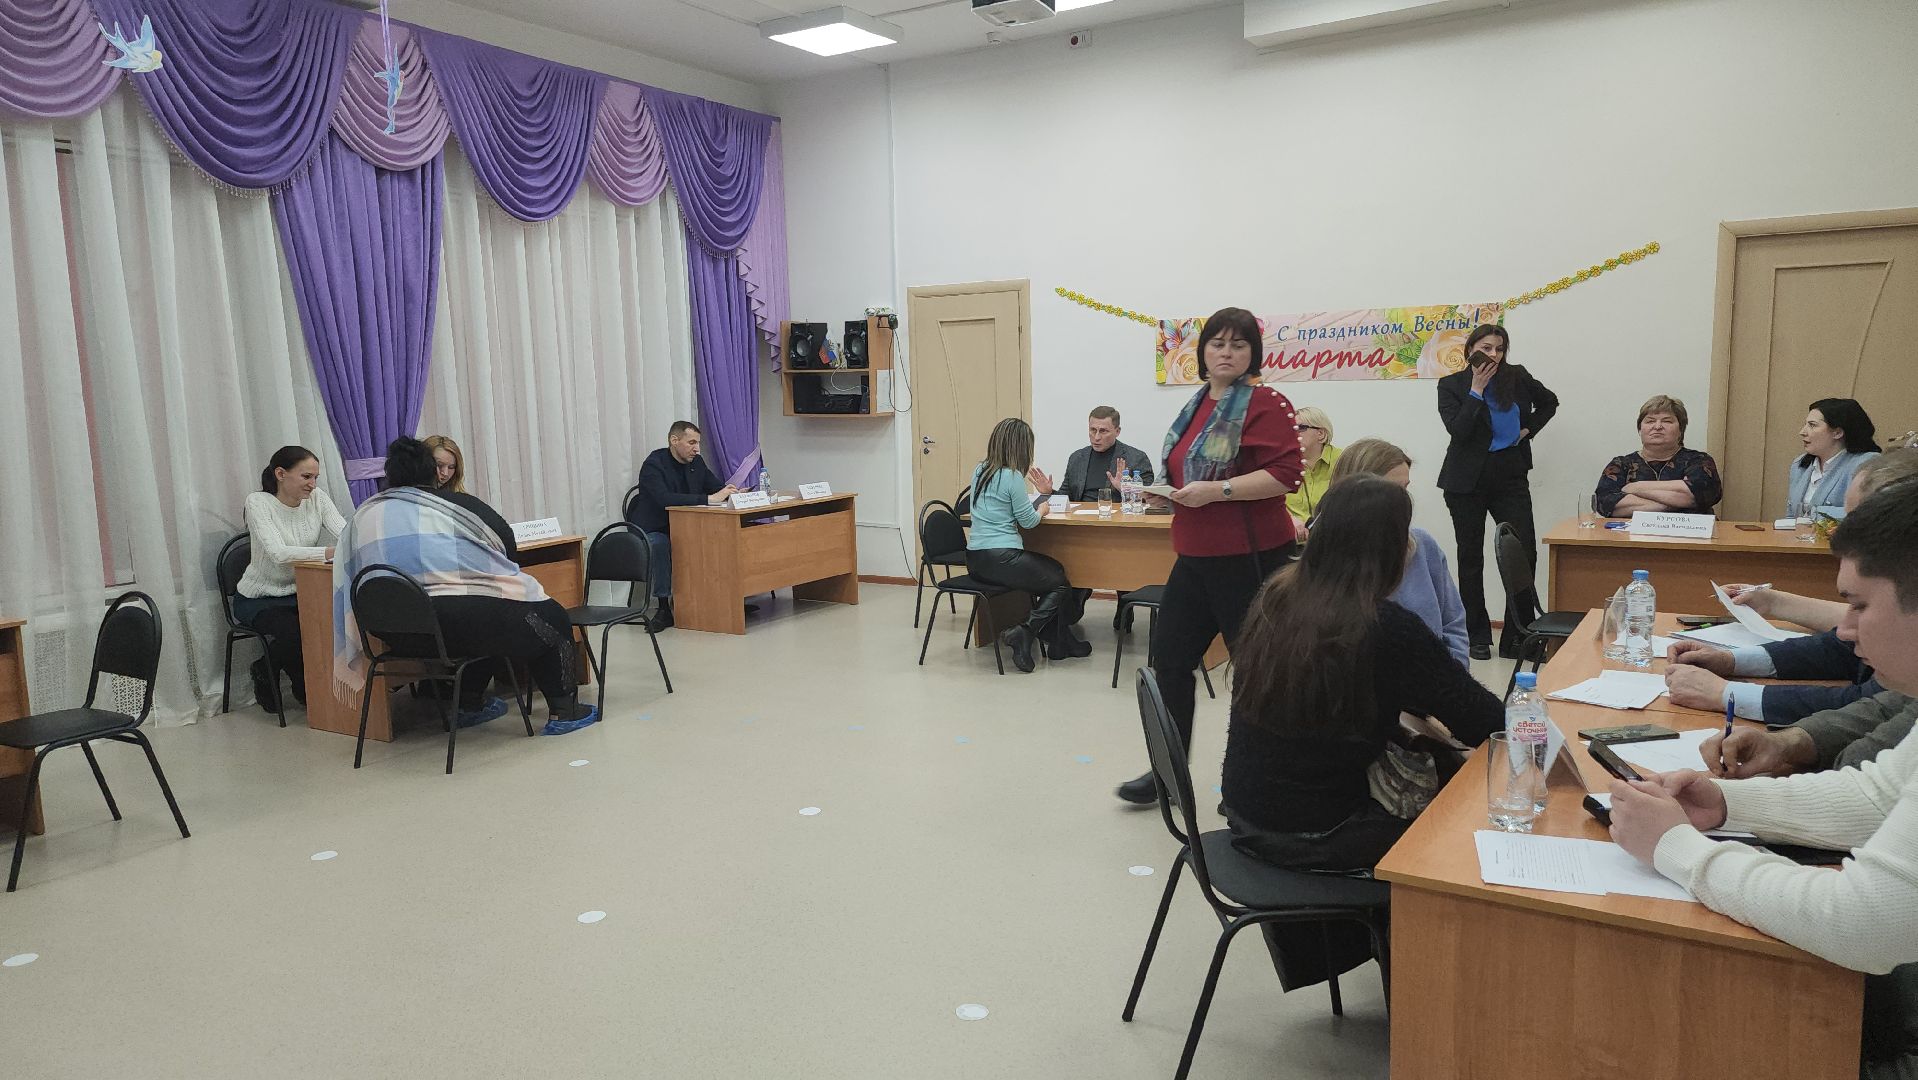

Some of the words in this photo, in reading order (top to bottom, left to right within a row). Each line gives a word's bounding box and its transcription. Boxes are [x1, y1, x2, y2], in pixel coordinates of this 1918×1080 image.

[1277, 325, 1289, 341] С
[1297, 322, 1403, 346] праздником
[1414, 307, 1480, 333] Весны!
[1260, 347, 1394, 379] марта
